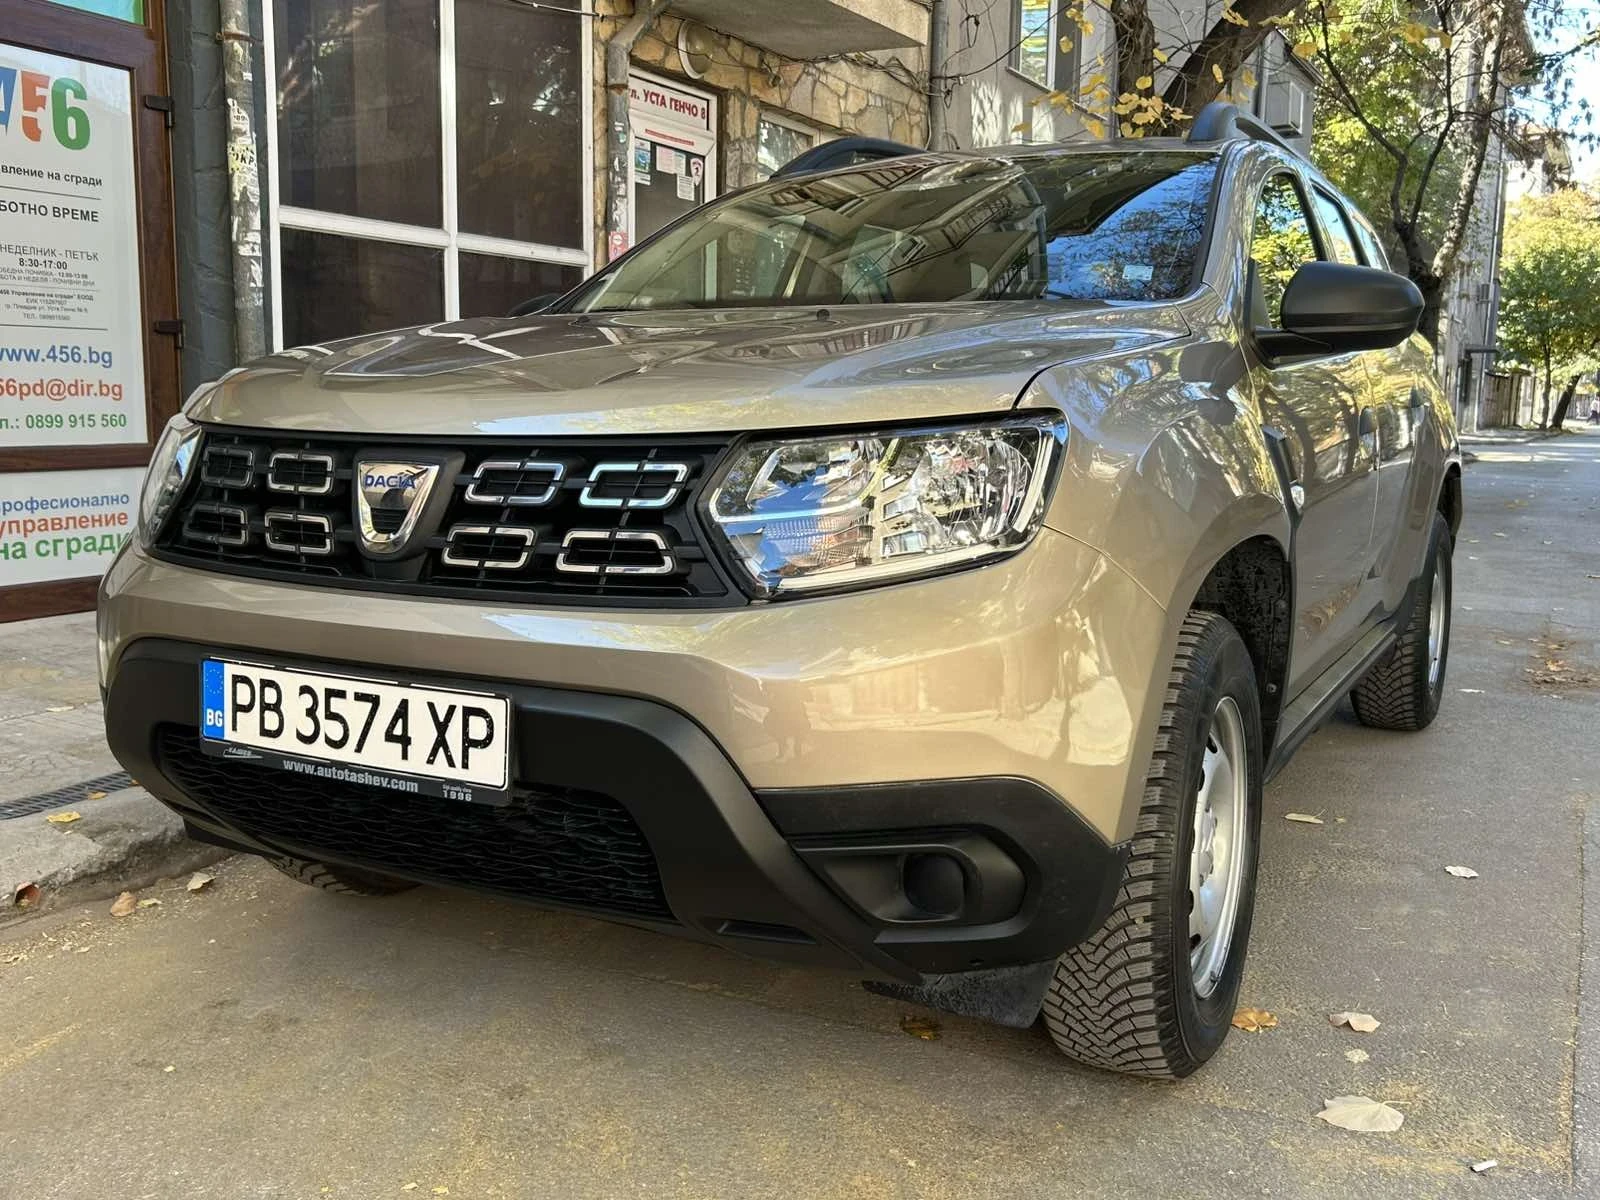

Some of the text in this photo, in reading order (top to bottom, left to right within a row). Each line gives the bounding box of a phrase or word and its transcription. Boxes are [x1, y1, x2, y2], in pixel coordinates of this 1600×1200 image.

[628, 88, 706, 120] л. УСТА ГЕНЧО 8
[1, 164, 103, 187] вление на сгради
[0, 200, 99, 222] БОТНО ВРЕМЕ
[19, 257, 68, 270] 8:30-17:00
[65, 249, 100, 262] ПЕТЪК
[0, 345, 113, 368] ww.456.bg
[25, 414, 64, 429] 0899
[69, 413, 96, 429] 915
[101, 413, 127, 428] 560
[364, 475, 416, 489] DACIA
[0, 494, 130, 515] рофесионално
[206, 708, 223, 728] BG
[231, 673, 495, 770] PB 3574 XP
[283, 759, 419, 793] www.autotashev.com
